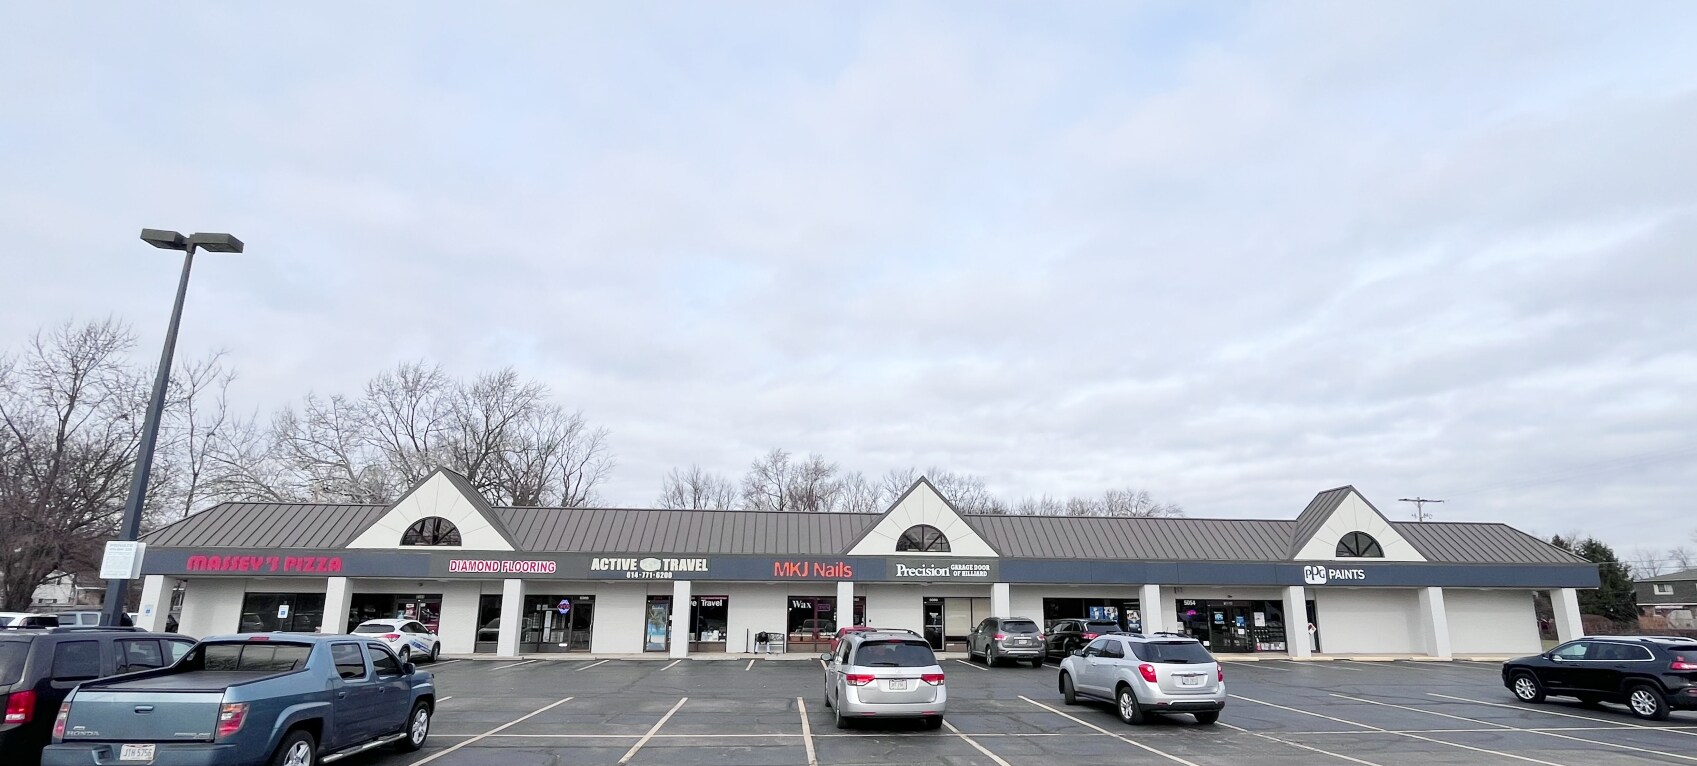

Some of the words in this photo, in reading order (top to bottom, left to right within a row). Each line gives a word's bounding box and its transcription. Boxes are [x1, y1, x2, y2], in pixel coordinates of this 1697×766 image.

[186, 555, 280, 572] MASSEY'S
[283, 556, 343, 573] PIZZA
[449, 560, 500, 572] DIAMOND
[501, 560, 557, 573] FLOORING
[591, 558, 638, 571] ACTIVE
[662, 558, 709, 571] TRAVEL
[774, 562, 809, 577] MKJ
[813, 562, 853, 577] Nails
[895, 563, 950, 577] Precision
[1305, 565, 1326, 581] PPG
[1328, 569, 1366, 580] PAINTS
[701, 599, 723, 607] Travel
[792, 600, 812, 609] Wax
